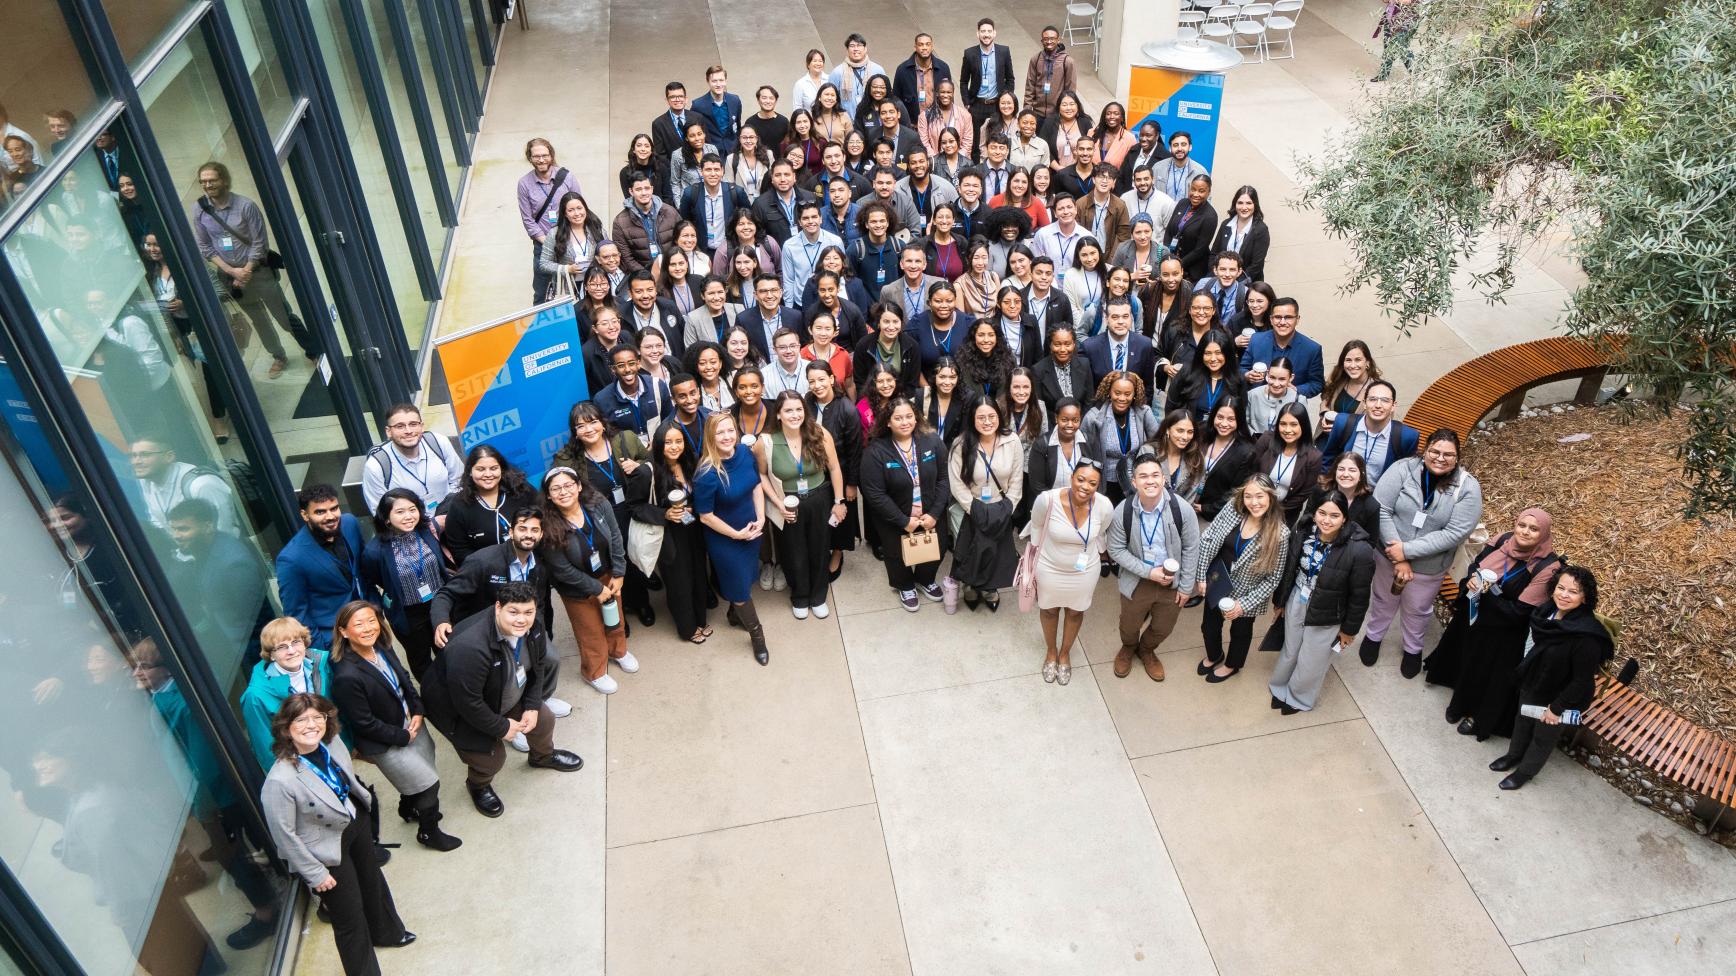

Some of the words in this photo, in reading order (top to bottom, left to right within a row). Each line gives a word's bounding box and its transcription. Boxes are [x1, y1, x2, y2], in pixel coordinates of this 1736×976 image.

[1131, 98, 1166, 112] SITY
[523, 343, 567, 363] UNIVERSITY
[525, 362, 536, 371] OF
[527, 357, 570, 377] CALIFORNIA
[455, 366, 505, 400] SITY
[461, 414, 516, 447] RNIA
